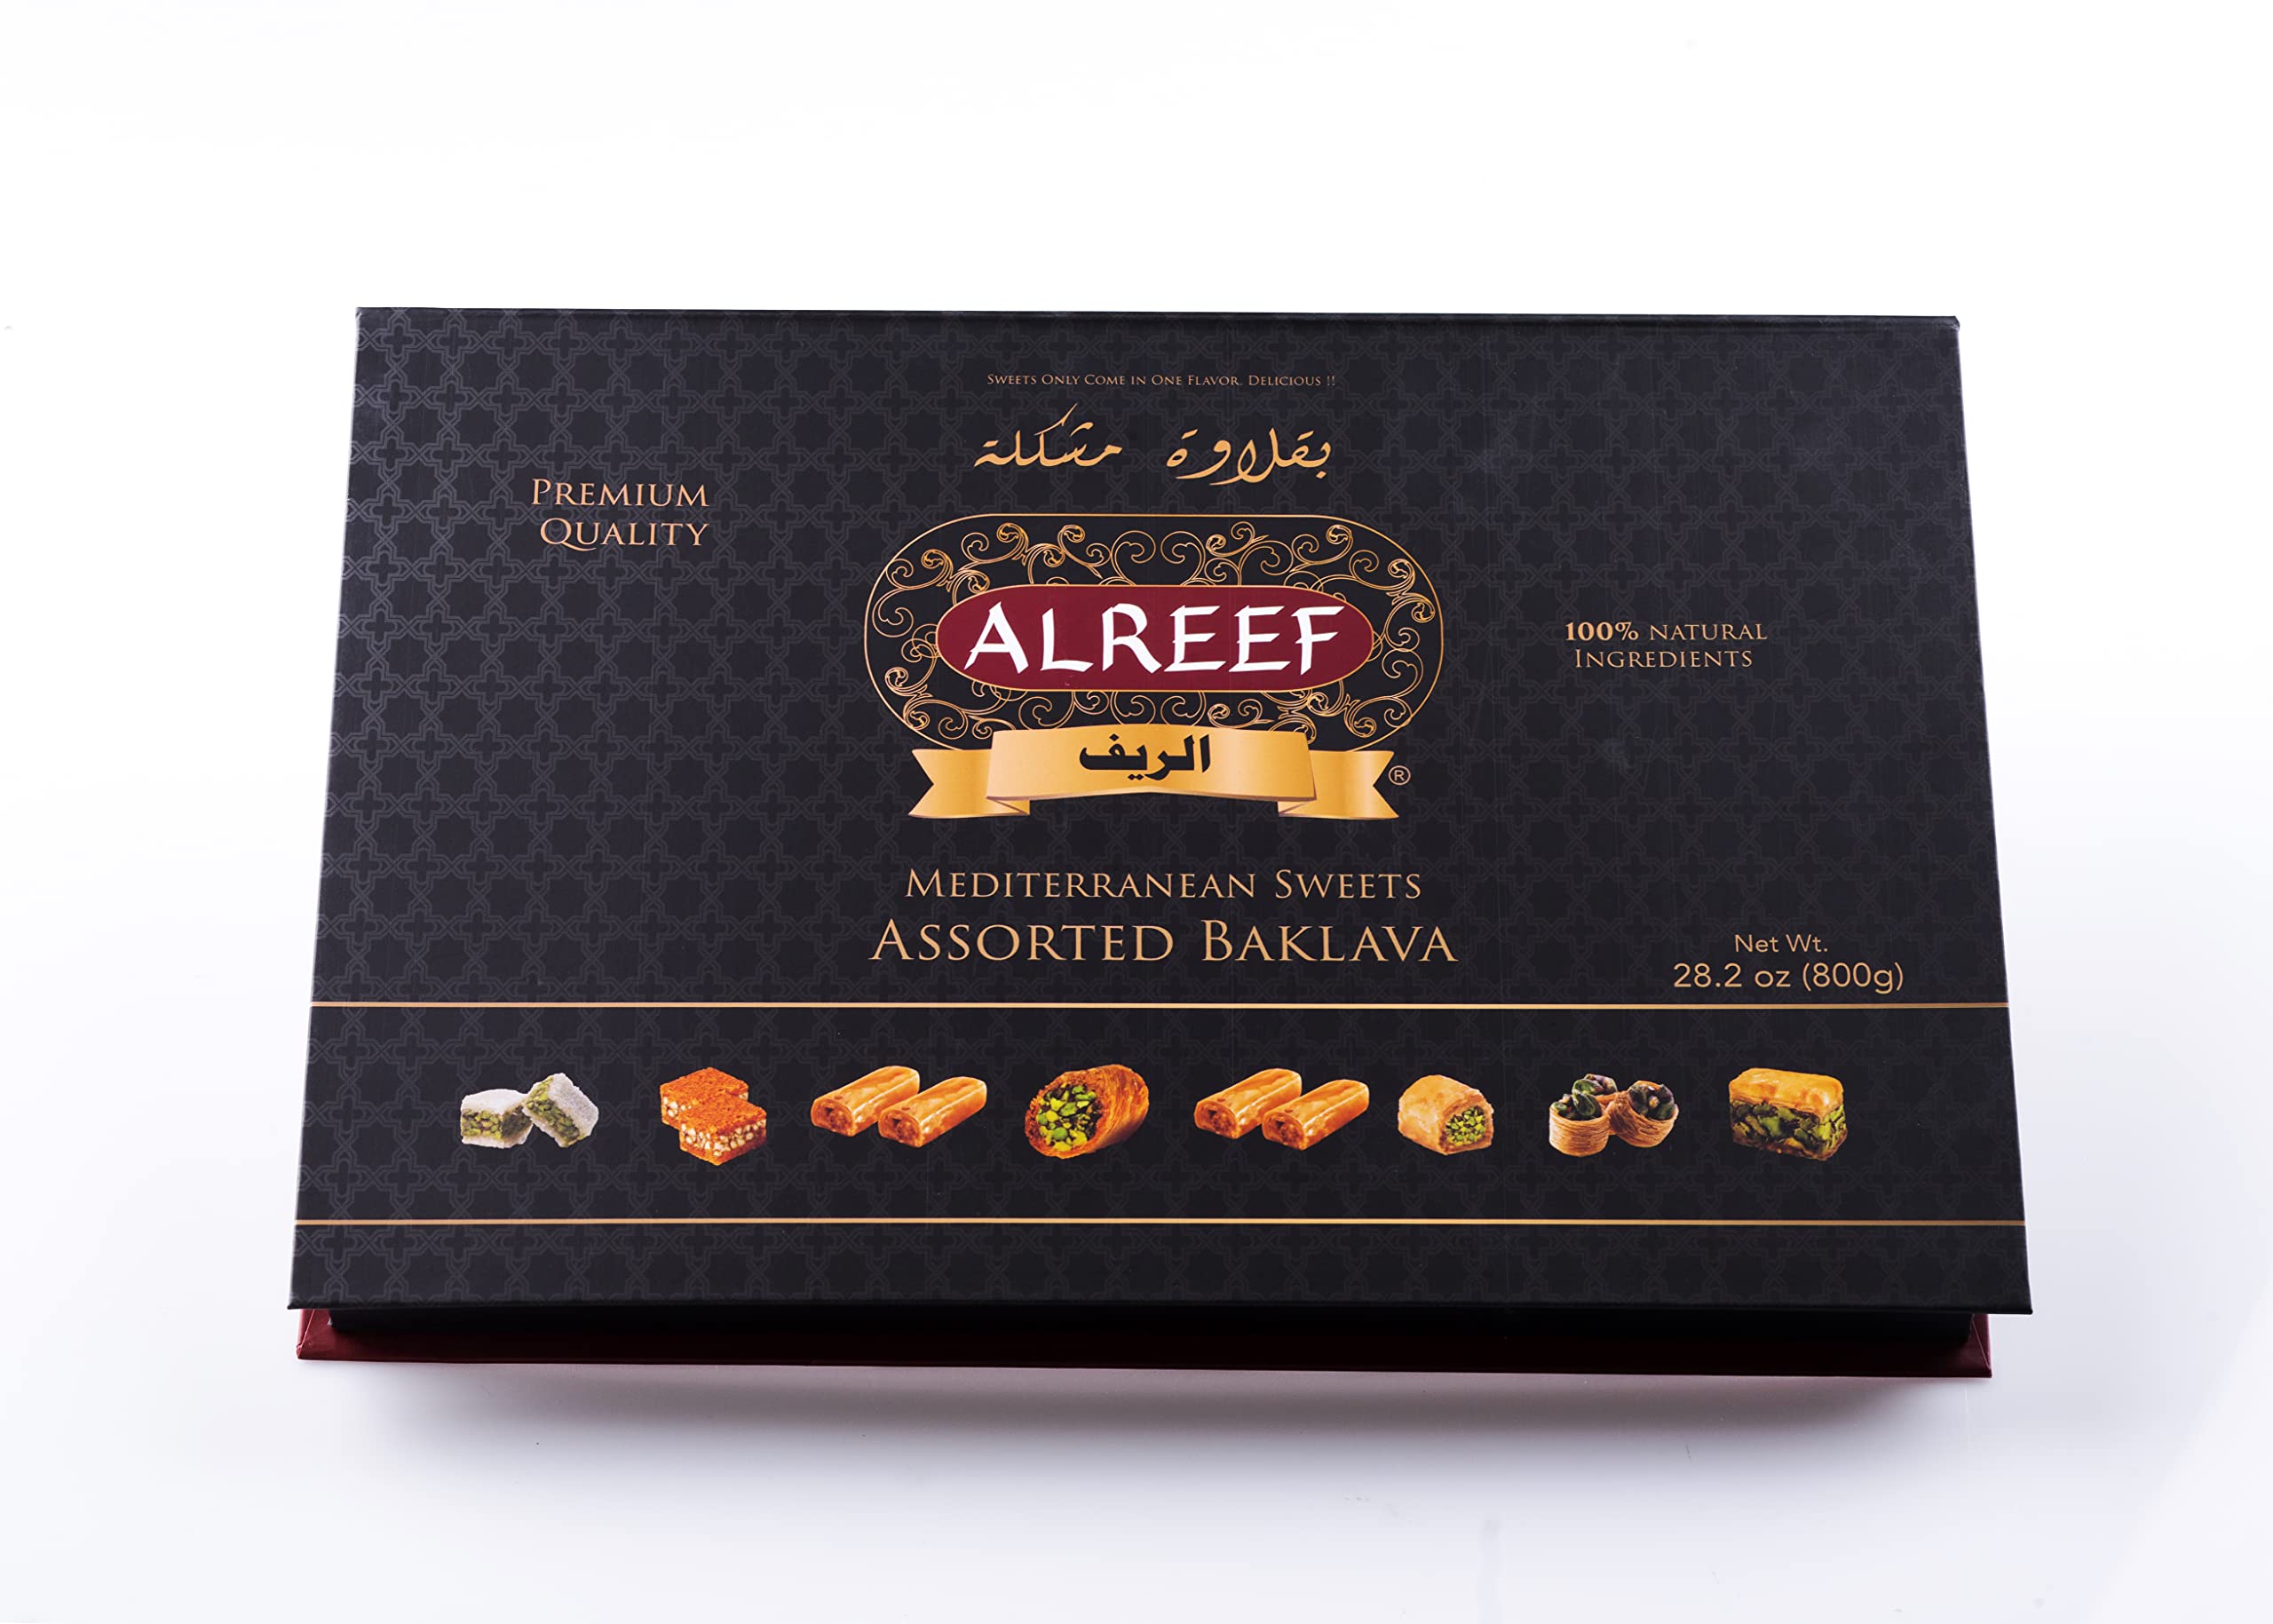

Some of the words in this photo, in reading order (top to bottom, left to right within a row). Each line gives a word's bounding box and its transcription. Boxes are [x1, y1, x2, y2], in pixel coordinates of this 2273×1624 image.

[987, 374, 1036, 385] SWEETS
[1041, 374, 1081, 385] ONLY
[1084, 374, 1126, 385] COME
[1130, 376, 1146, 385] IN
[1151, 374, 1183, 385] ONE
[1188, 374, 1242, 385] FLAVOR.
[1248, 375, 1321, 386] DELICIOUS
[974, 402, 1123, 468] مشكلة
[1166, 427, 1332, 486] بقلاوة
[532, 477, 709, 508] PREMIUM
[539, 517, 709, 552] QUALITY
[963, 600, 1344, 675] ALREEF
[1565, 621, 1640, 641] 100%
[1649, 623, 1768, 641] NATURAL
[1575, 649, 1753, 669] INGREDIENTS
[1078, 733, 1211, 780] الريف
[906, 867, 1255, 899] MEDITERRANEAN
[1274, 867, 1422, 899] SWEETS
[869, 917, 1175, 963] ASSORTED
[1202, 918, 1459, 963] BAKLAVA
[1734, 933, 1779, 953] Net
[1786, 933, 1828, 954] Wt.
[1673, 963, 1743, 988] 28.2
[1754, 970, 1792, 988] oz
[1802, 962, 1905, 994] (800g)
